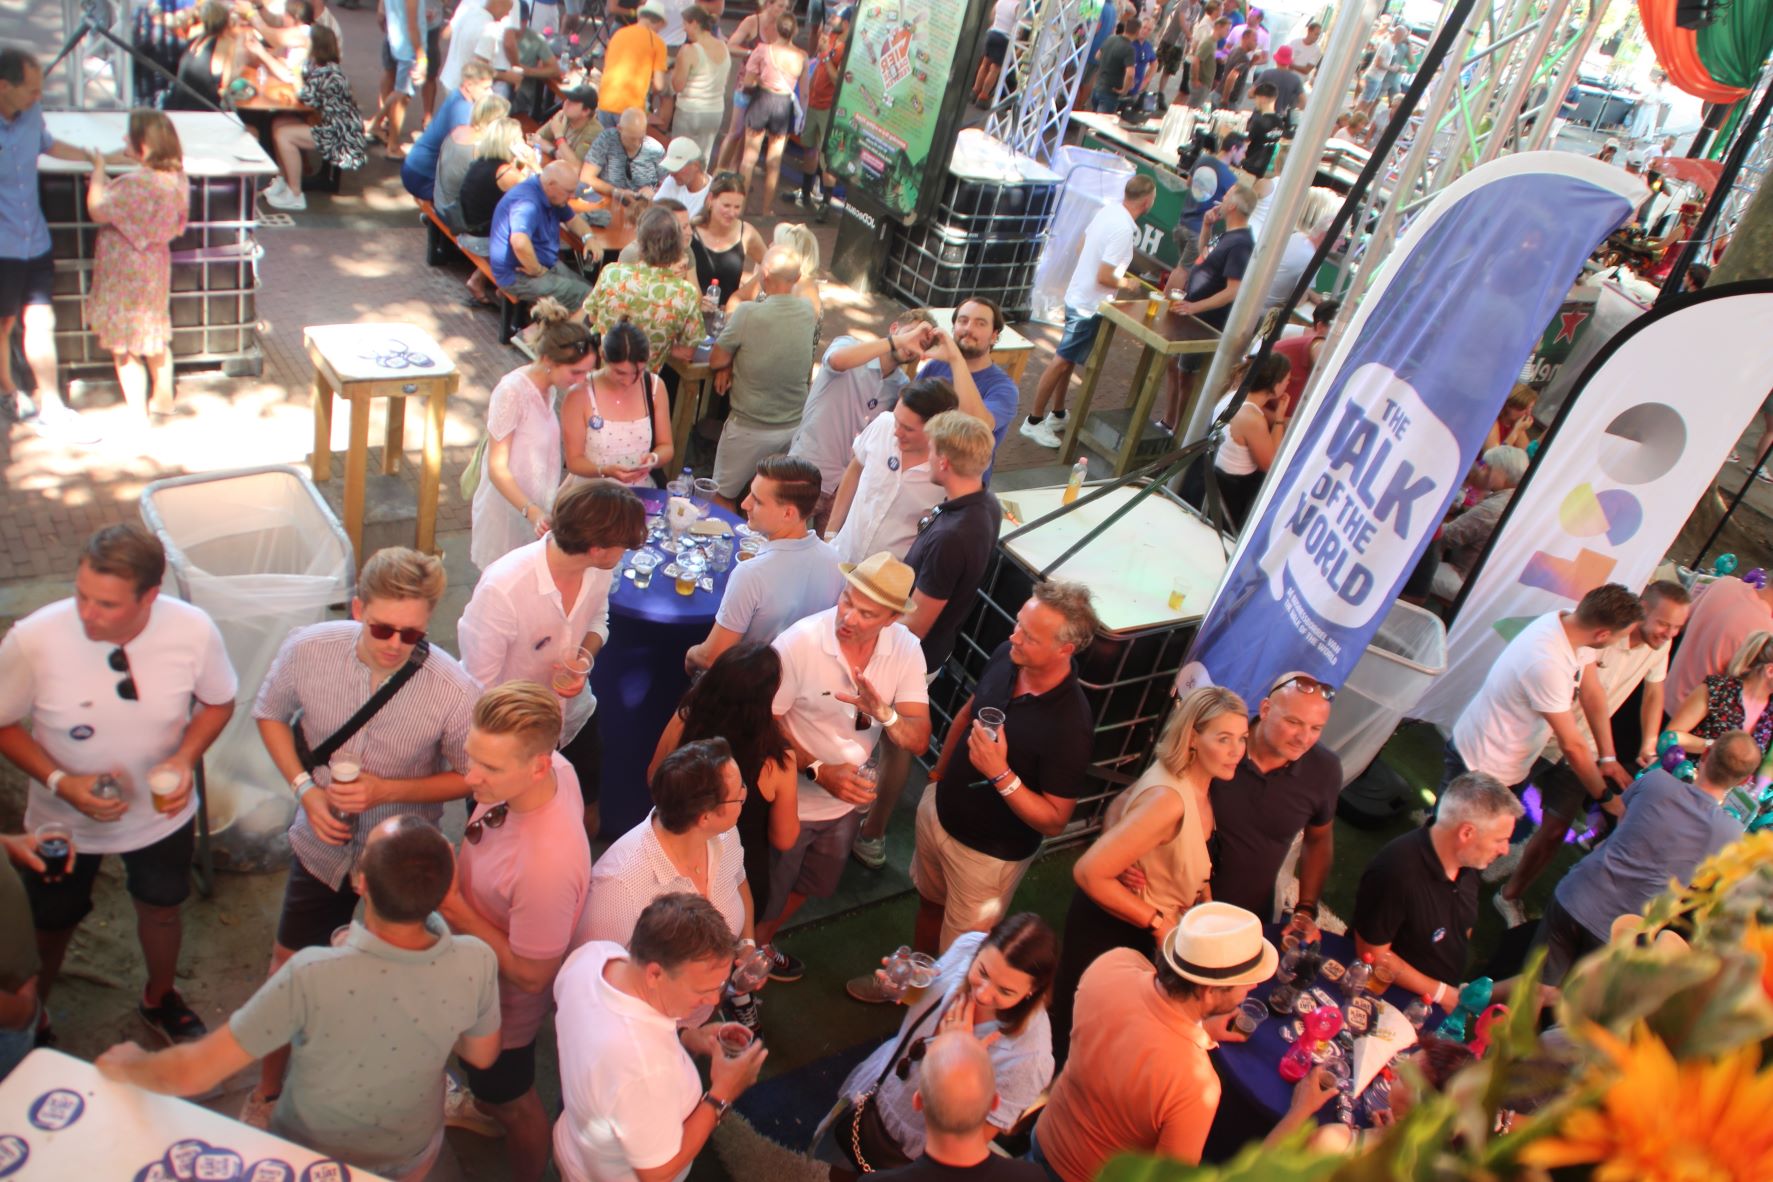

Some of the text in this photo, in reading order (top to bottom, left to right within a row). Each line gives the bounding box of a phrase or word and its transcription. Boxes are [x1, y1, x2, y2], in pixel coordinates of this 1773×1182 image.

[1382, 398, 1411, 440] THE
[1310, 472, 1378, 555] OF THE
[1326, 398, 1437, 540] TALK
[1285, 491, 1375, 606] WORLD
